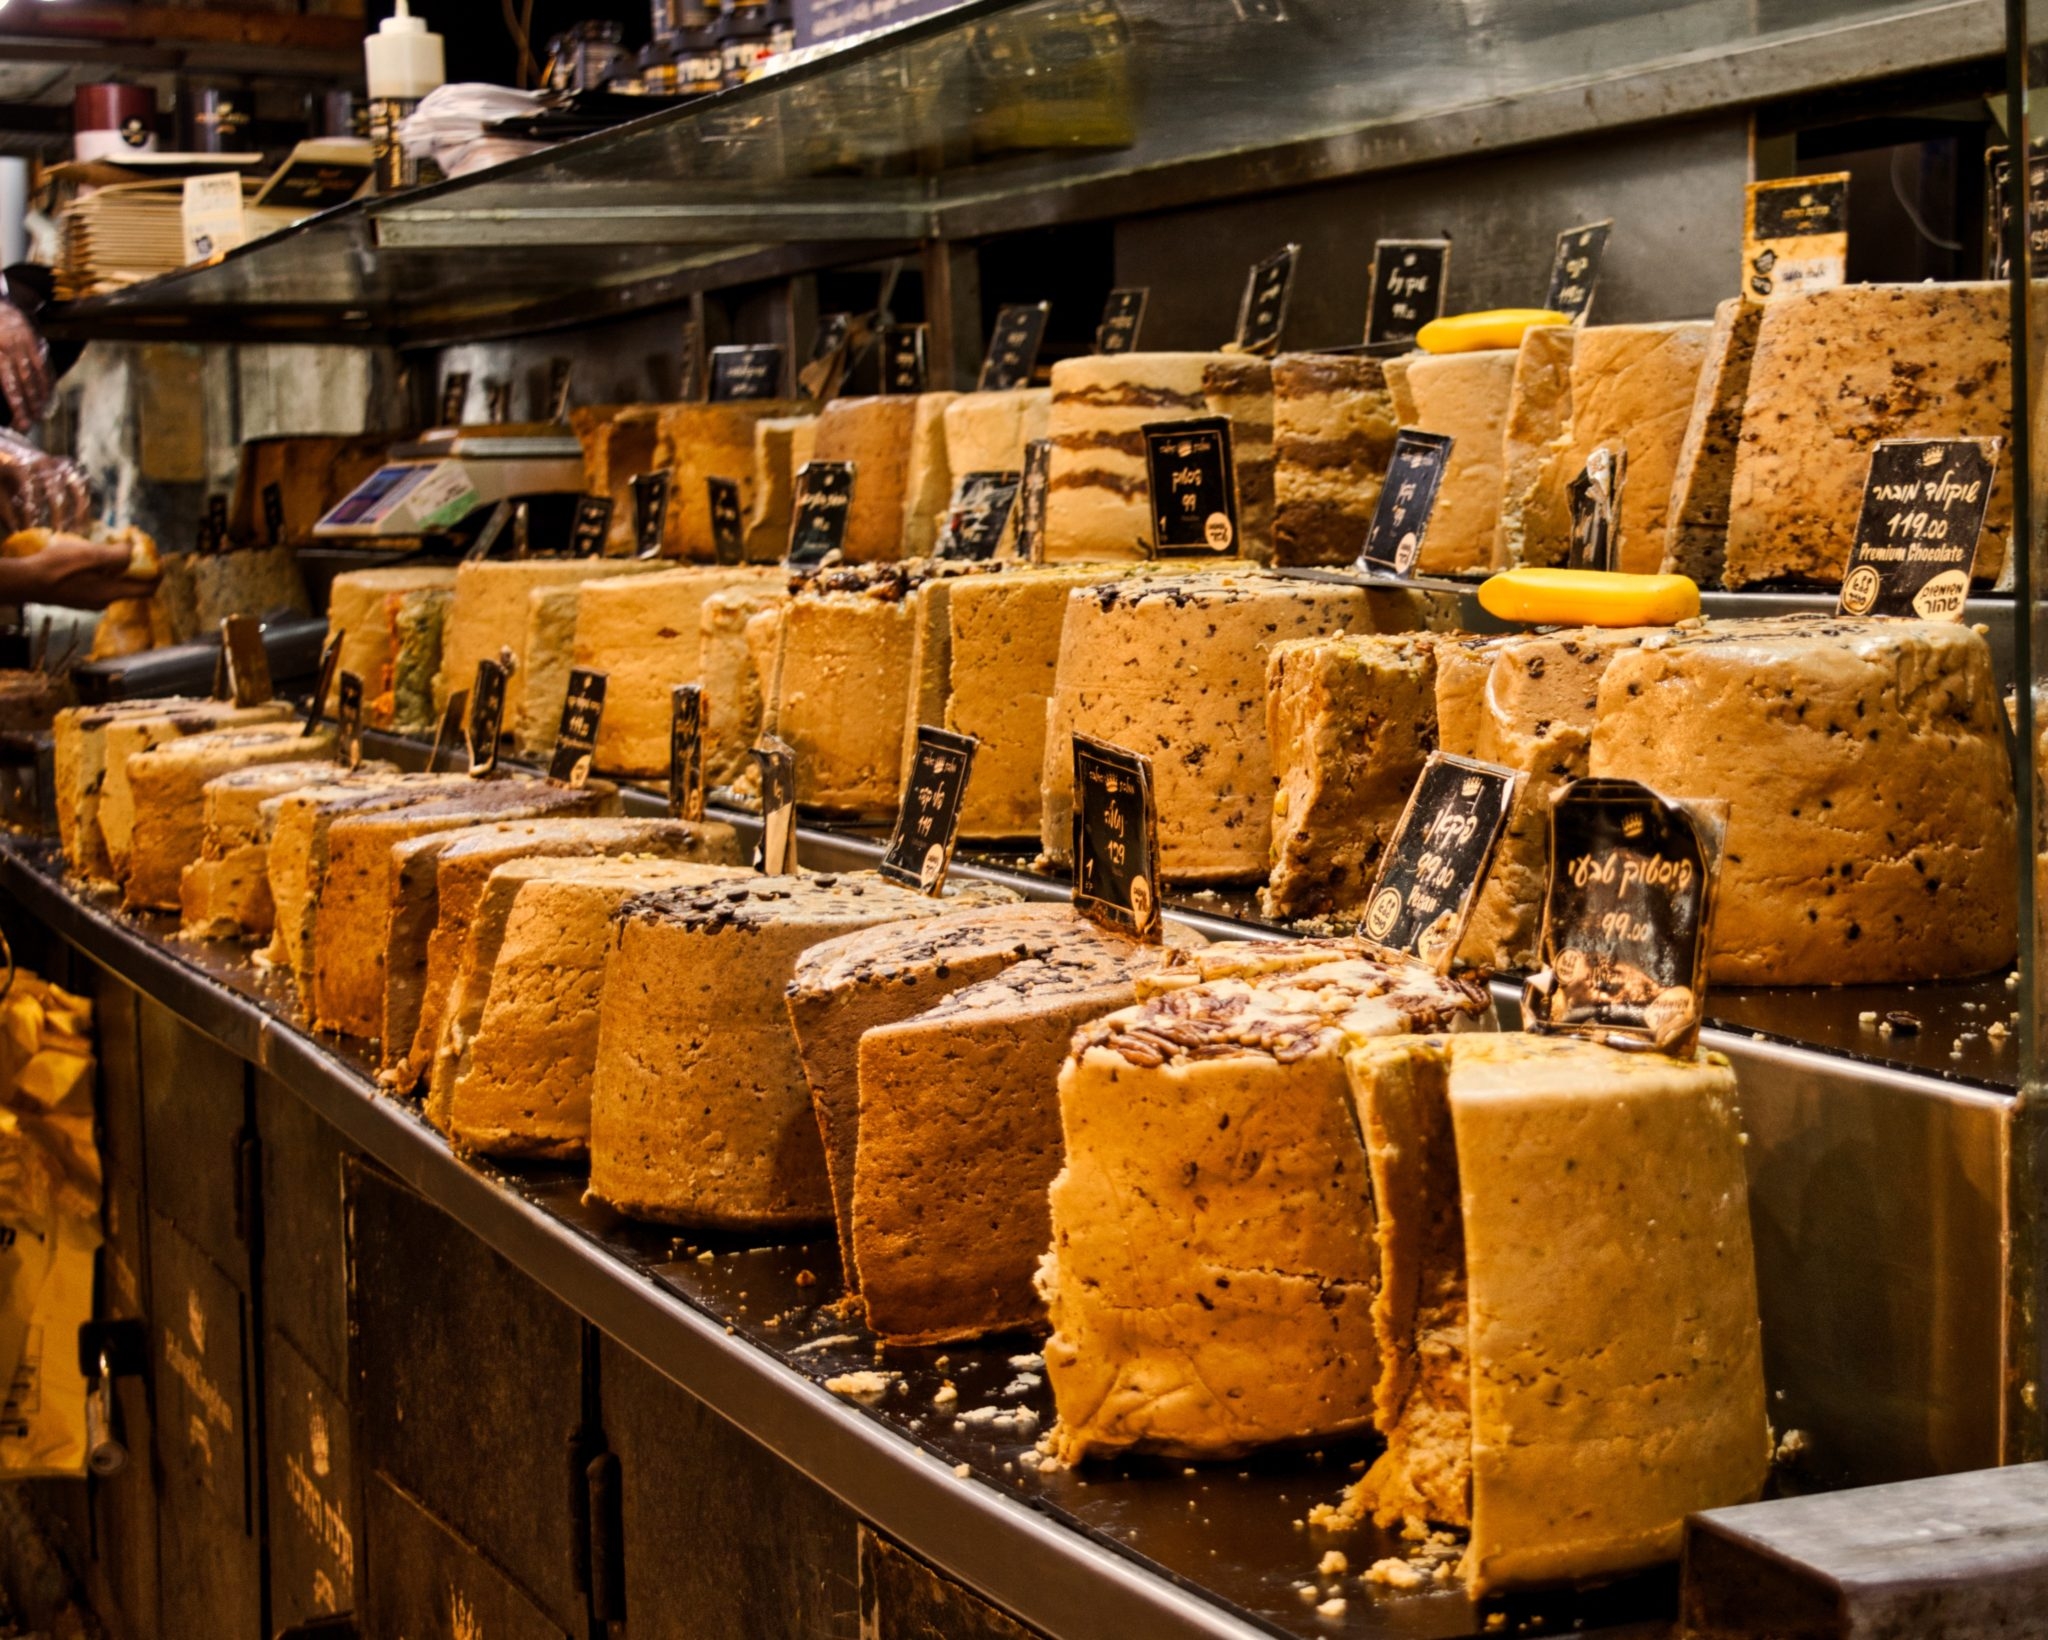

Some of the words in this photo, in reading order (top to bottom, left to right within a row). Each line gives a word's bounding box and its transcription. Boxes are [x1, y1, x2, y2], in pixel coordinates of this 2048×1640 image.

[1872, 480, 1921, 504] מובחר
[1924, 470, 1981, 511] שוקולד
[1887, 512, 1948, 540] 119.00
[1859, 543, 1905, 561] Premium
[1907, 543, 1964, 562] Chocolate
[1924, 597, 1960, 614] טהור
[1107, 840, 1125, 866] 129
[1086, 858, 1094, 878] 1
[1417, 851, 1455, 889] 99.00
[1568, 852, 1618, 889] טבעי
[1617, 852, 1692, 899] פיסטוק
[1407, 884, 1438, 913] Pecan
[1601, 912, 1649, 942] 99.00
